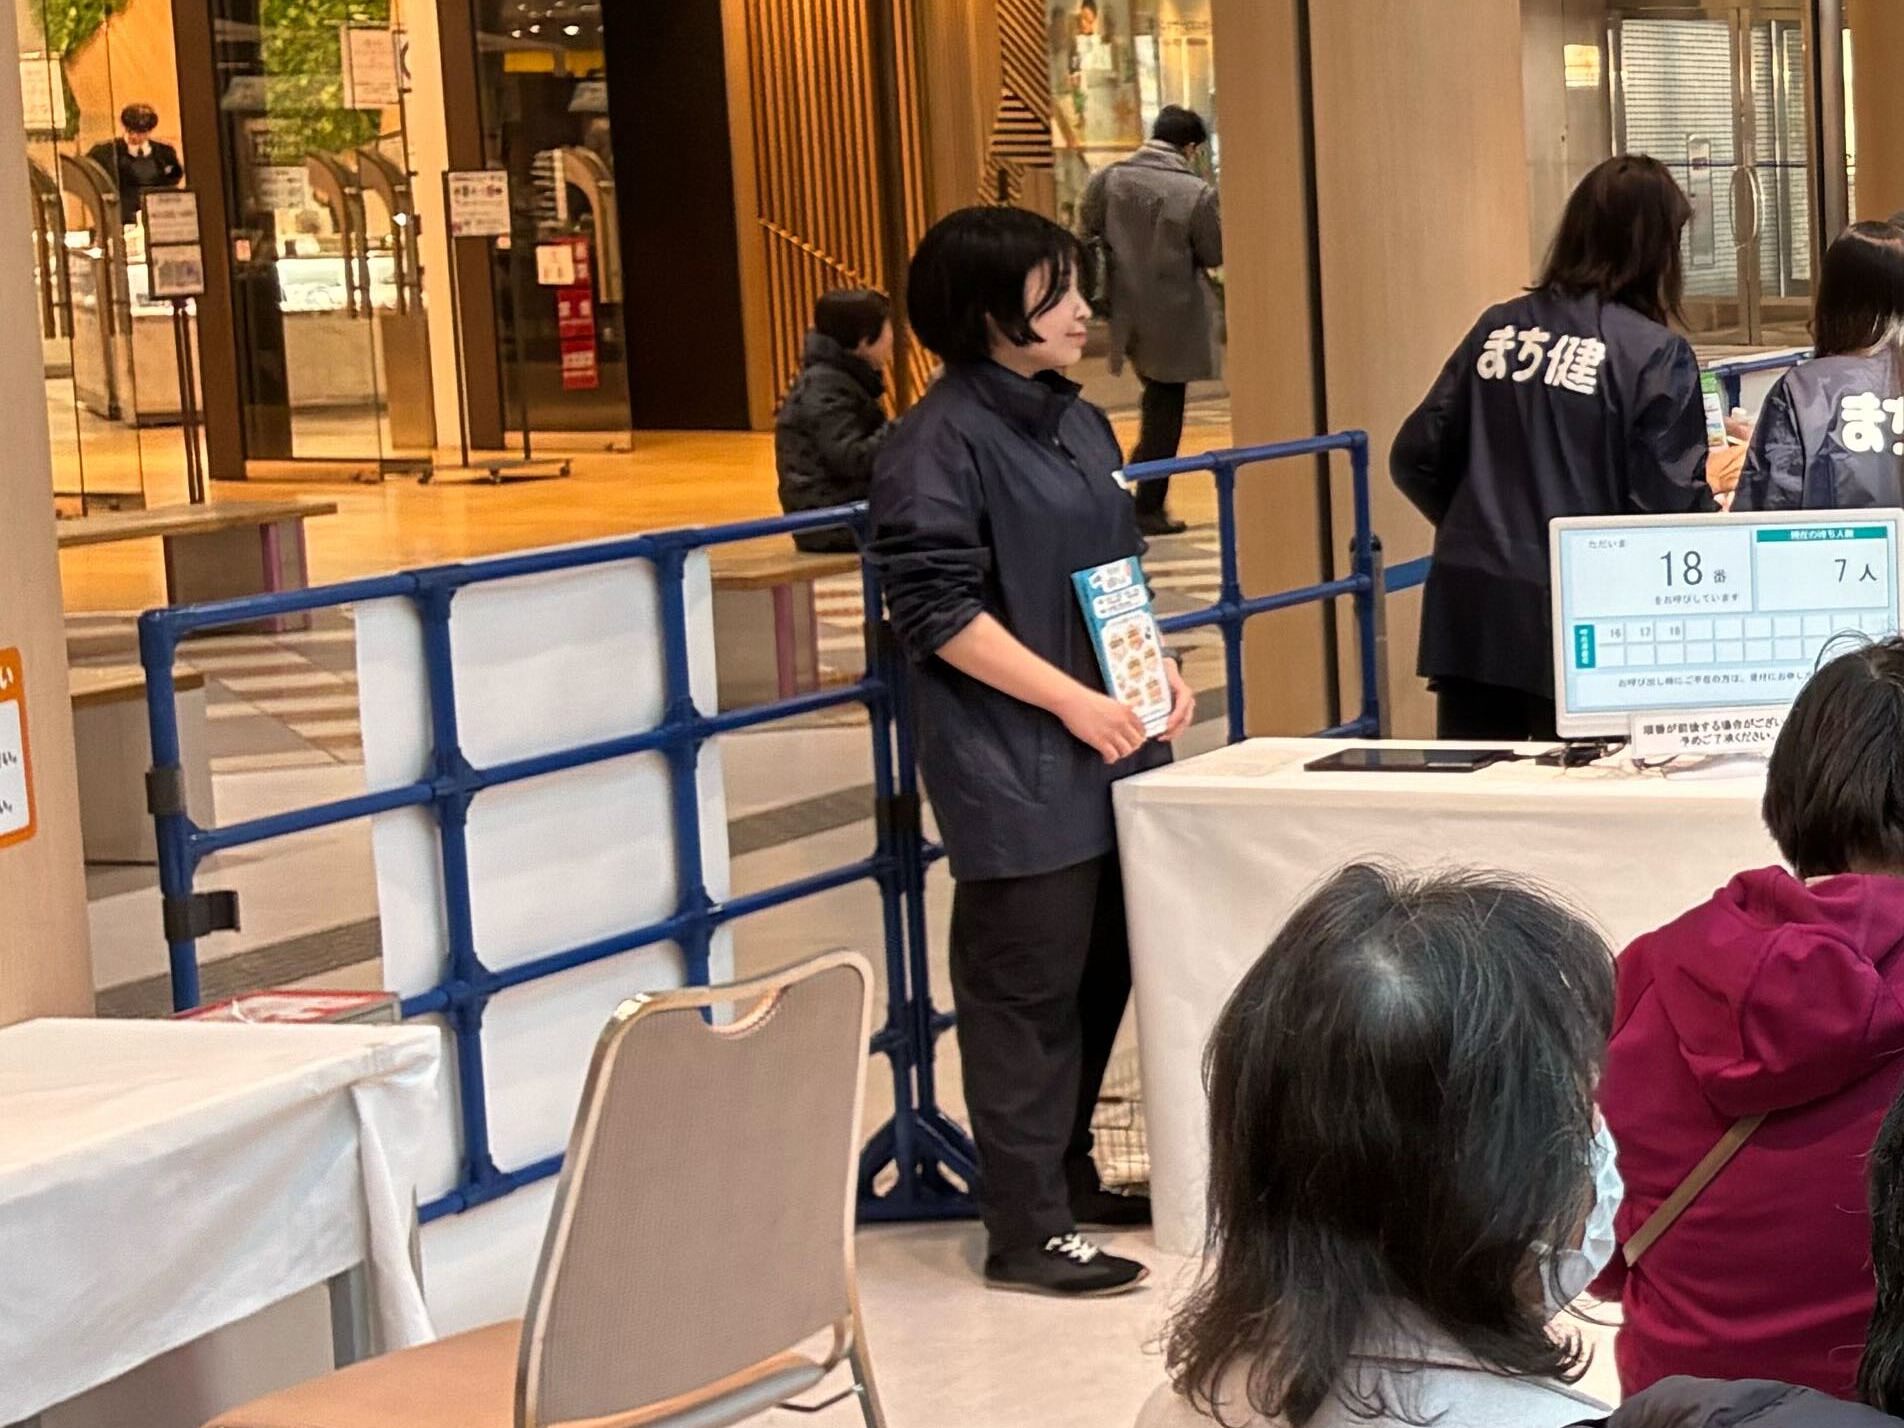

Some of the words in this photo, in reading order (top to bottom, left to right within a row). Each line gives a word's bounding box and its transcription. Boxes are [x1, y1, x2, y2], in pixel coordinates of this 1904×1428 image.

[1475, 324, 1607, 396] まち健
[1659, 549, 1704, 587] 18
[1712, 569, 1728, 584] 番
[1833, 558, 1848, 583] 7
[1858, 563, 1878, 582] 人
